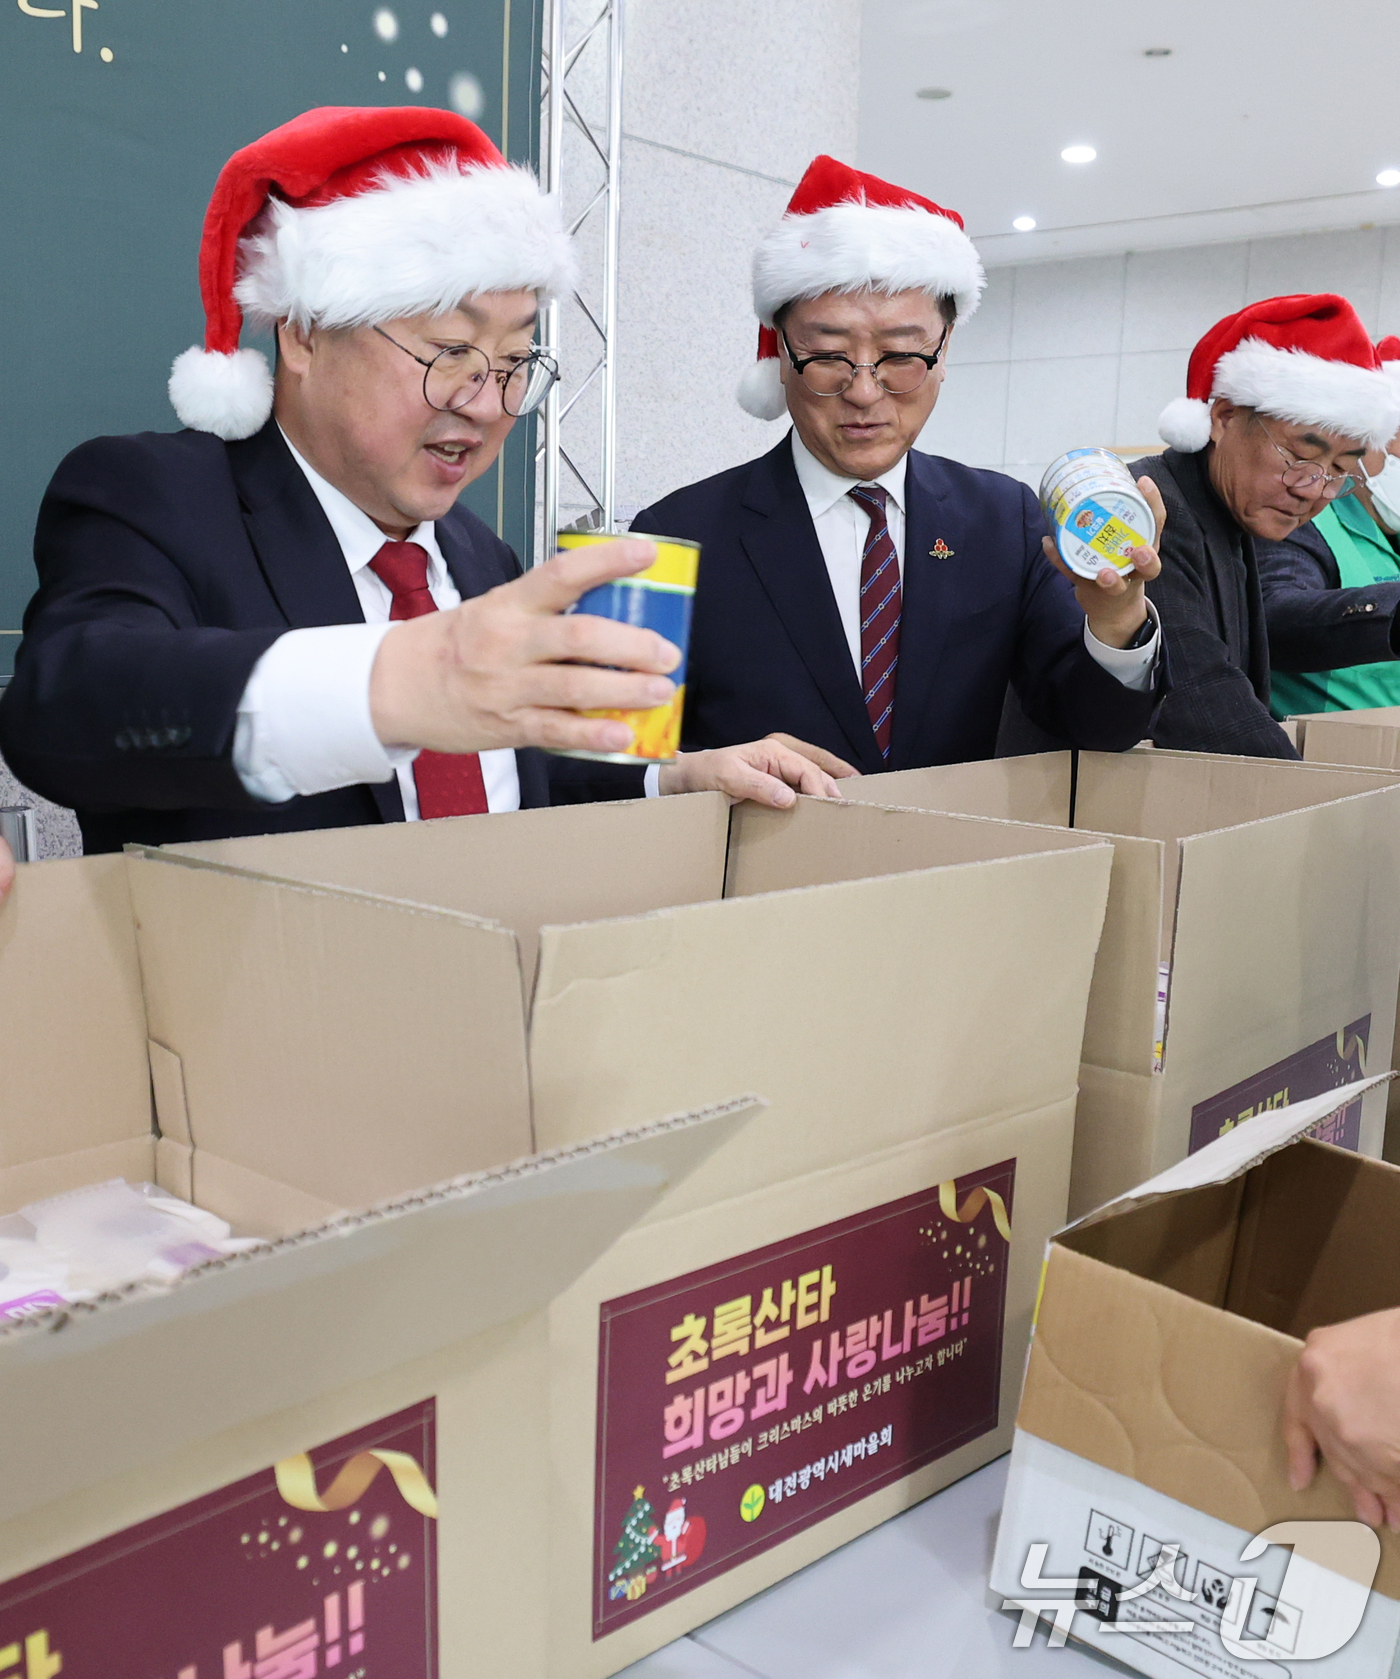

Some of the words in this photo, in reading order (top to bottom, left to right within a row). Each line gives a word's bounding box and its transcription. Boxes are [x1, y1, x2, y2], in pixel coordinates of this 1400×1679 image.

[1096, 523, 1117, 545] 참치
[1103, 528, 1130, 554] 가벼운
[662, 1353, 794, 1459] 희망과
[803, 1276, 973, 1395] 사랑나눔!!
[664, 1264, 836, 1385] 초록산타
[756, 1406, 823, 1451] 크리스마스의
[827, 1390, 858, 1418] 따뜻한
[862, 1374, 892, 1402] 온기를
[895, 1355, 934, 1386] 나누고자
[768, 1424, 893, 1504] 대전광역시새마을회
